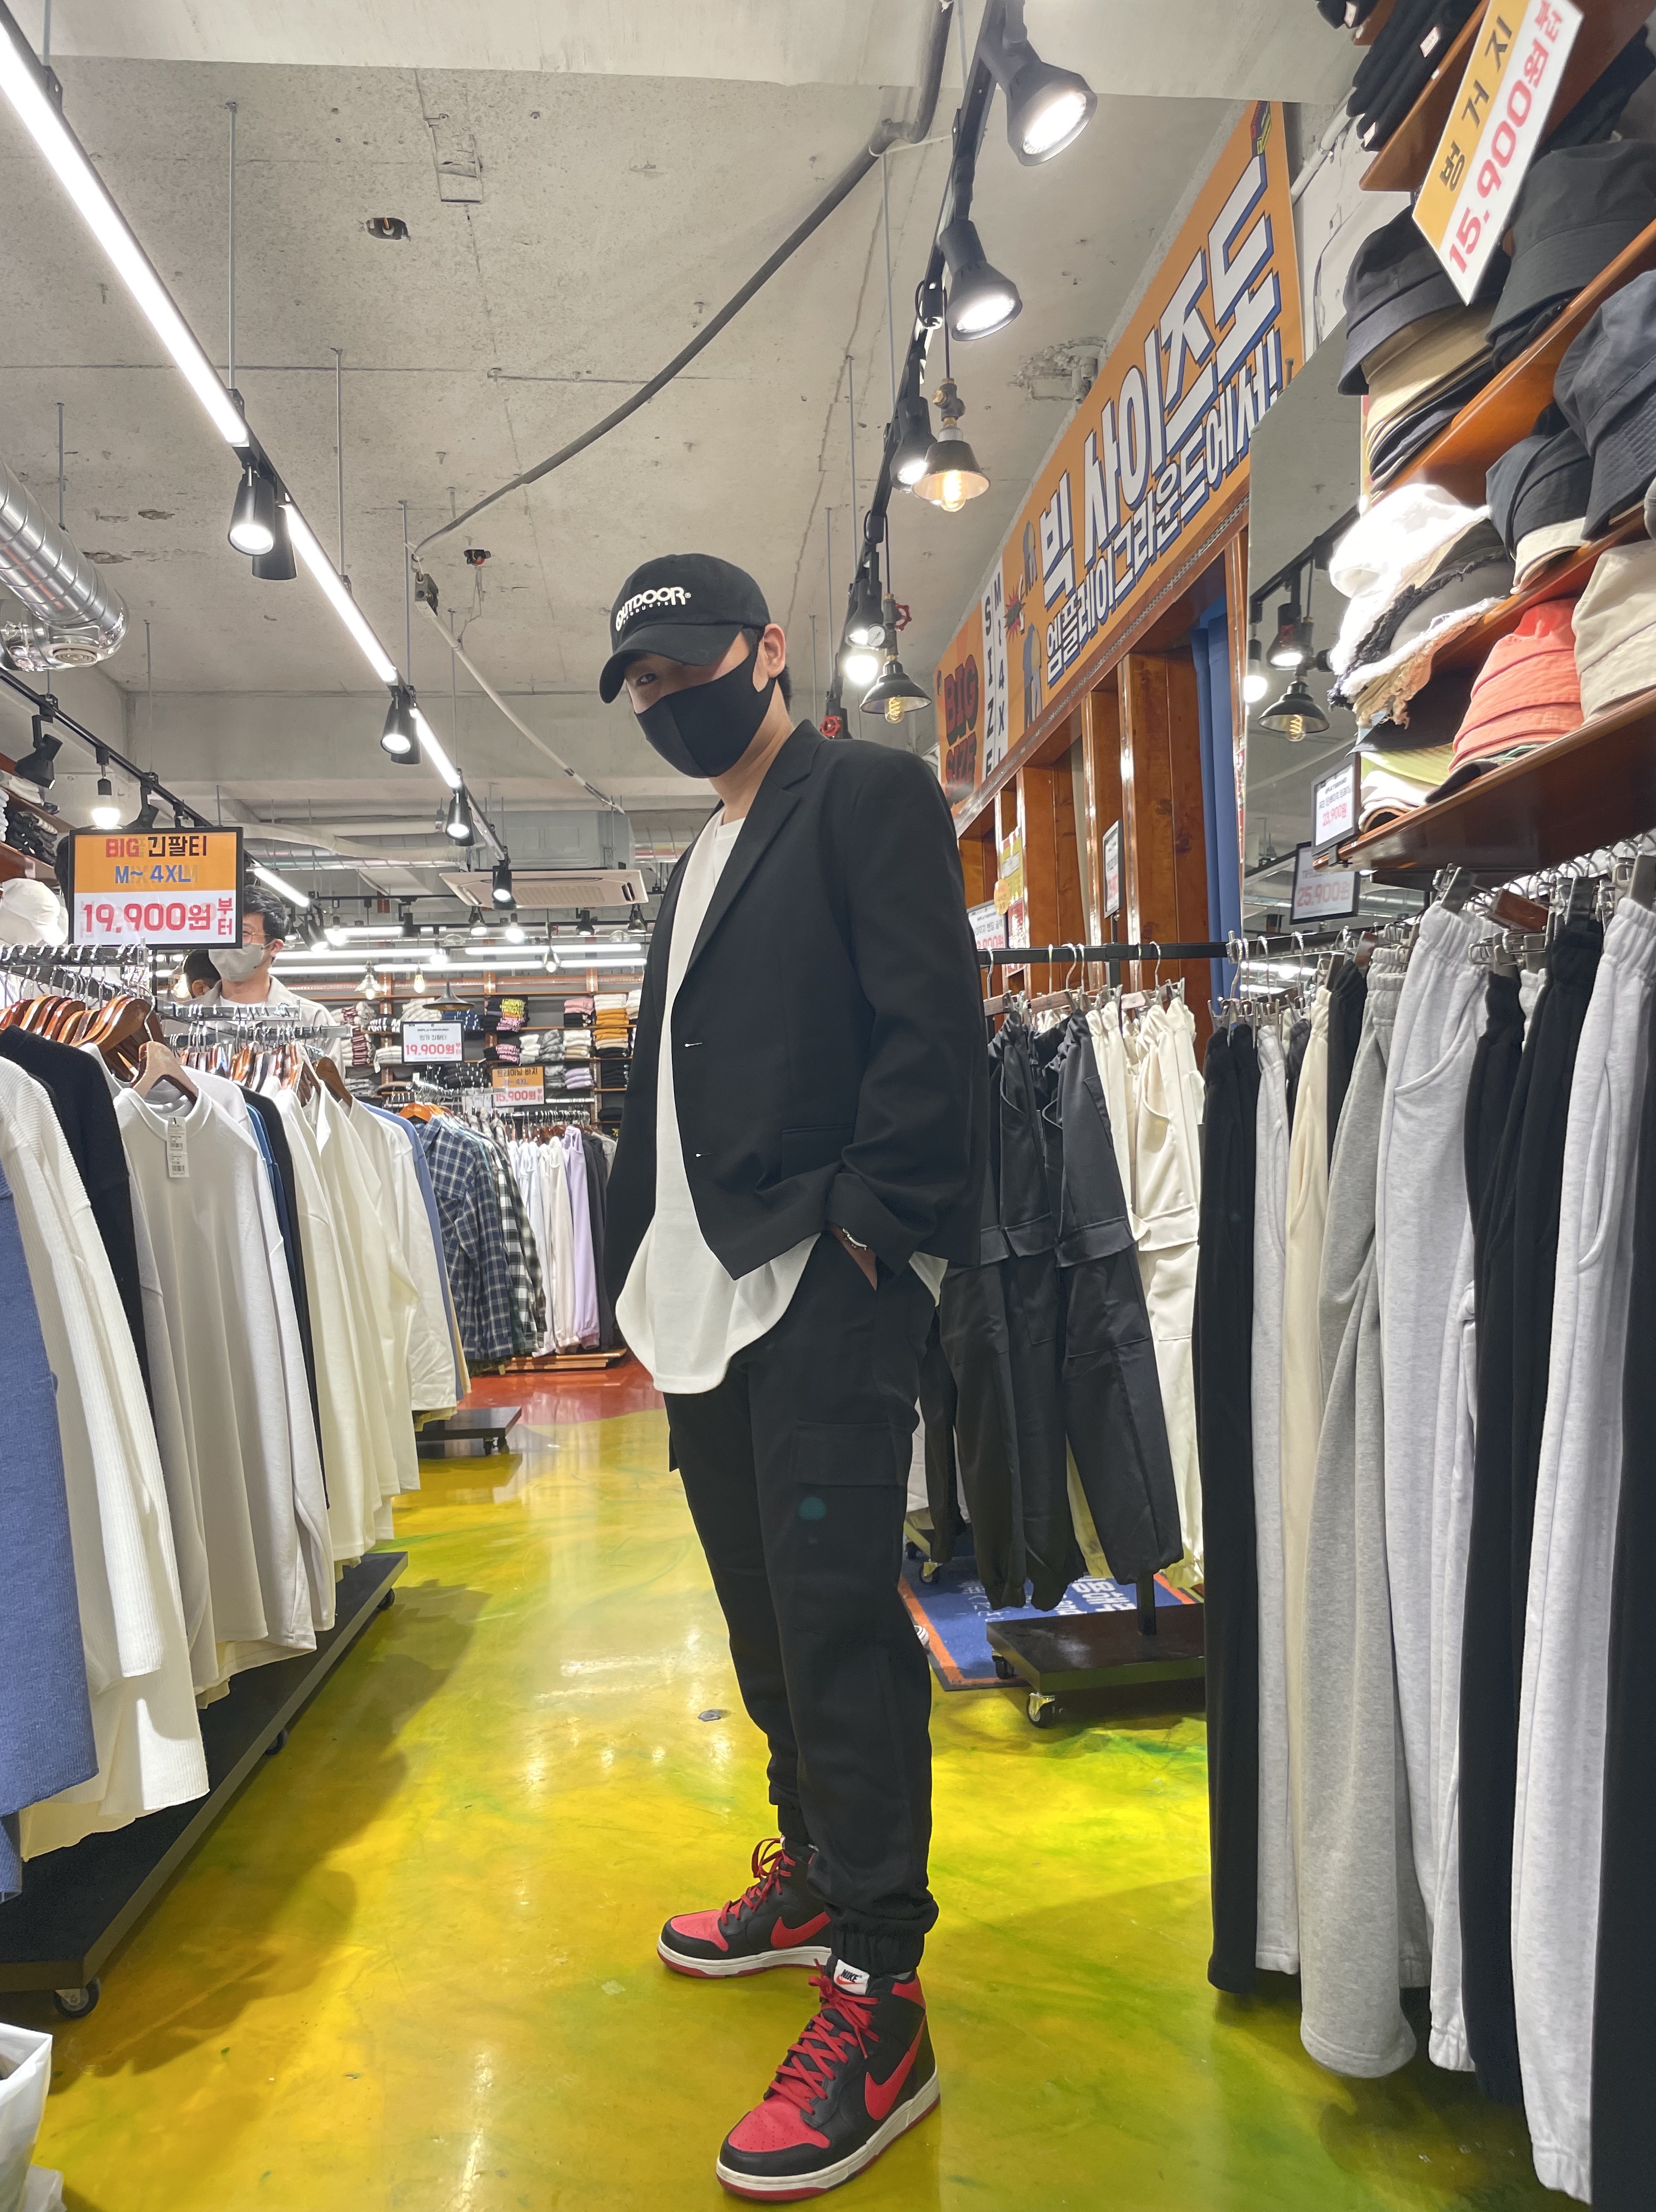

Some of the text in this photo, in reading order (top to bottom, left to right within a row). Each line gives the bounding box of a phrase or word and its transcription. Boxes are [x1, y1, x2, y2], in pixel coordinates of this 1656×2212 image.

[1039, 153, 1282, 612] 빅 사이즈도
[615, 586, 686, 631] OUTDOOR
[944, 654, 979, 747] BIG
[946, 731, 977, 808] SIZE
[105, 836, 207, 857] BIG 긴팔티
[115, 865, 191, 884] M~ 4XL
[217, 898, 234, 935] 부터
[498, 1067, 538, 1077] 트레이닝 바지
[841, 1969, 860, 1984] NIKE
